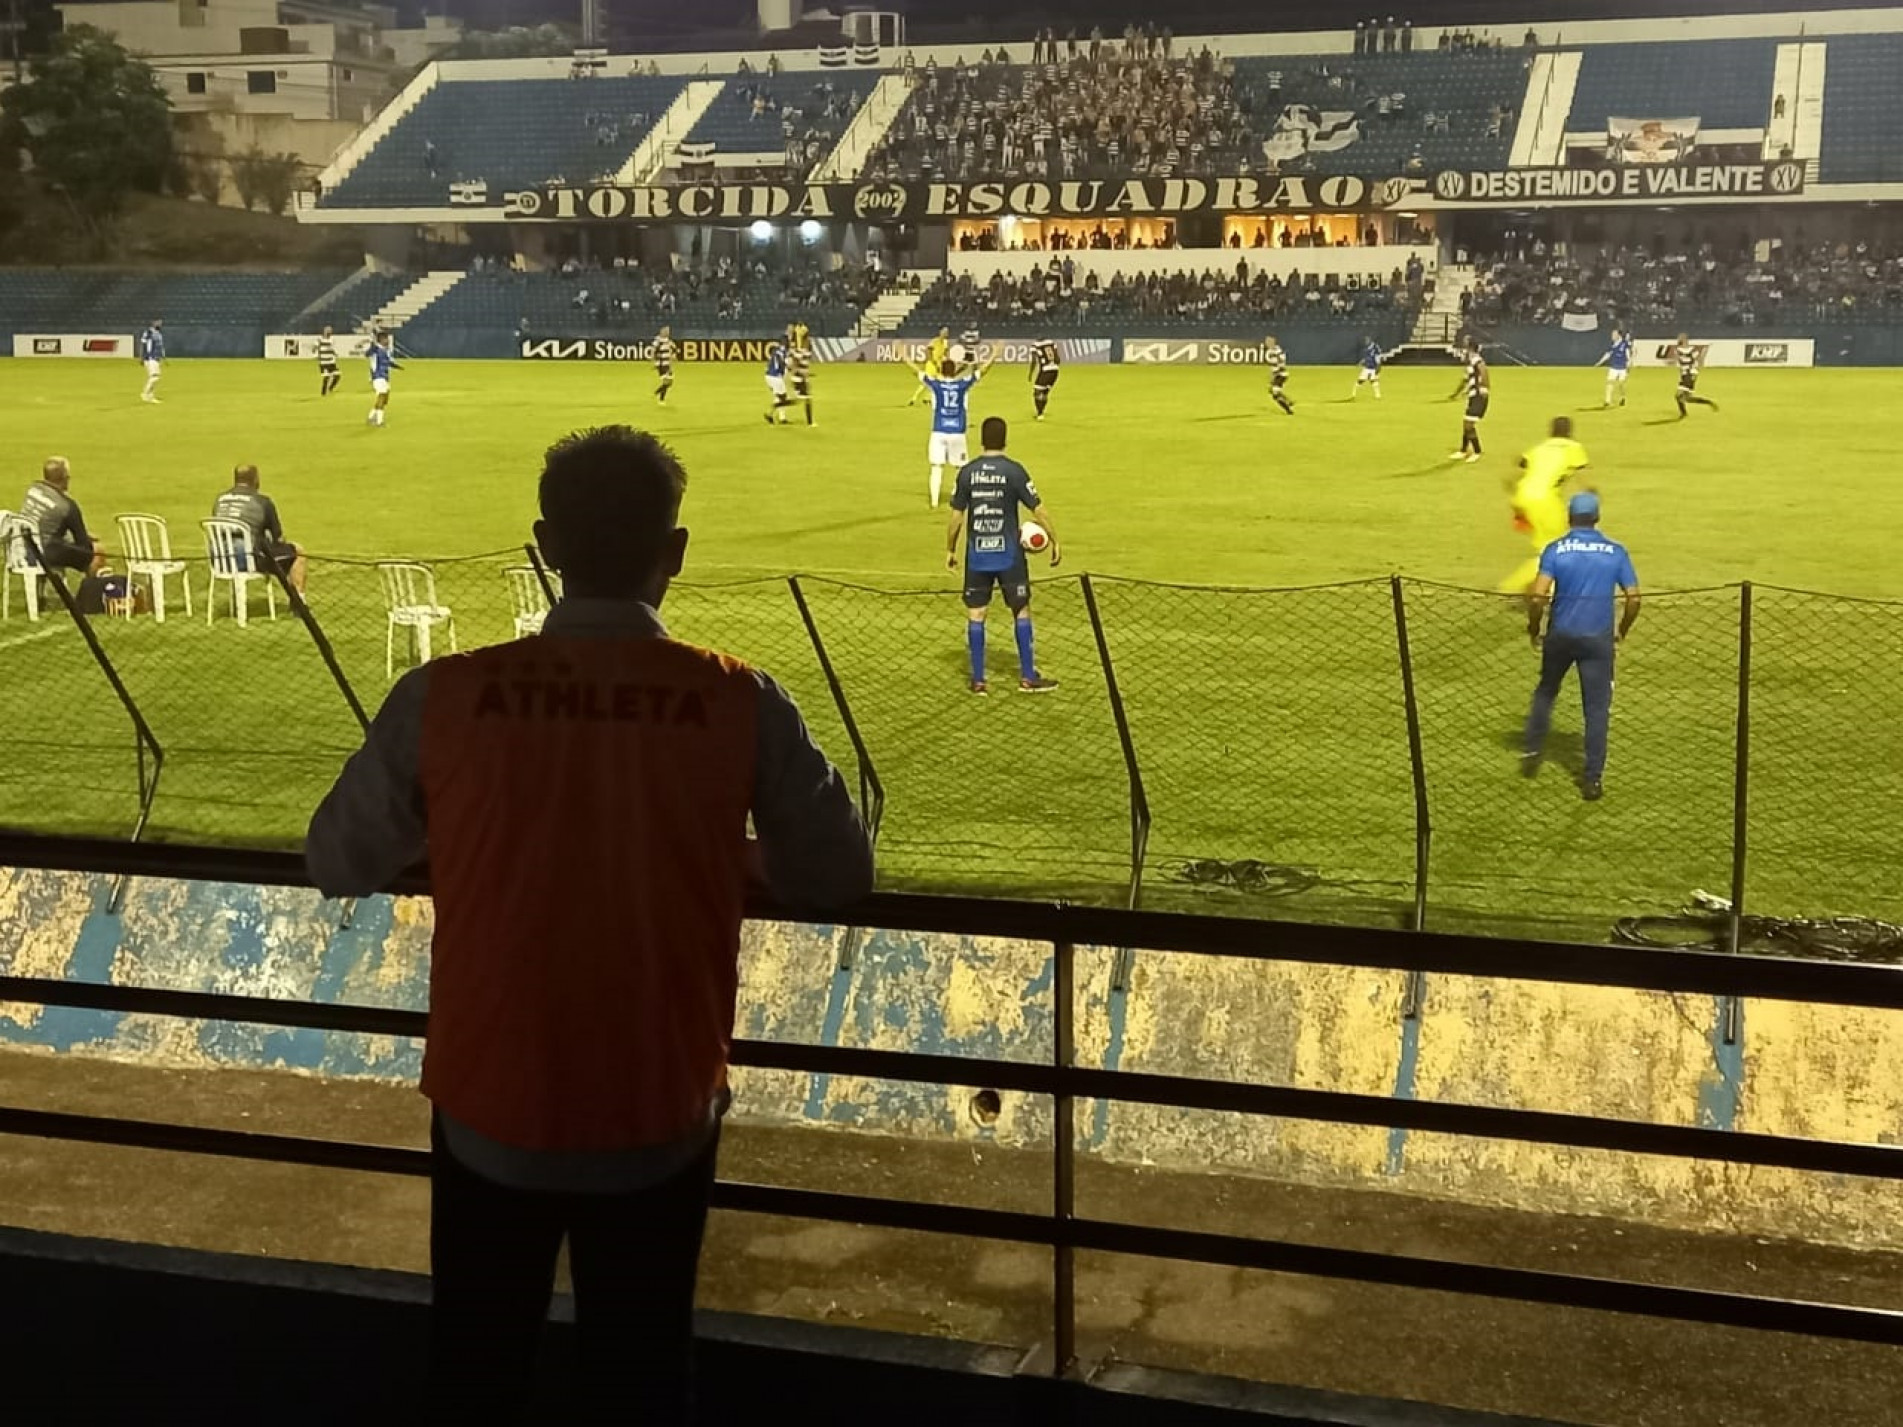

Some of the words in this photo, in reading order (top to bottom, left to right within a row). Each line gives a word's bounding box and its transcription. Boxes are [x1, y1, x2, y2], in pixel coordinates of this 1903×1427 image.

[925, 175, 1364, 215] ESQUADRAO
[1470, 168, 1617, 197] DESTEMIDO
[1622, 168, 1642, 195] E
[1646, 164, 1763, 194] VALENTE
[547, 185, 834, 218] TORCIDA
[683, 341, 782, 360] BINANC
[943, 390, 959, 407] 12
[473, 680, 709, 730] ATHLETA
